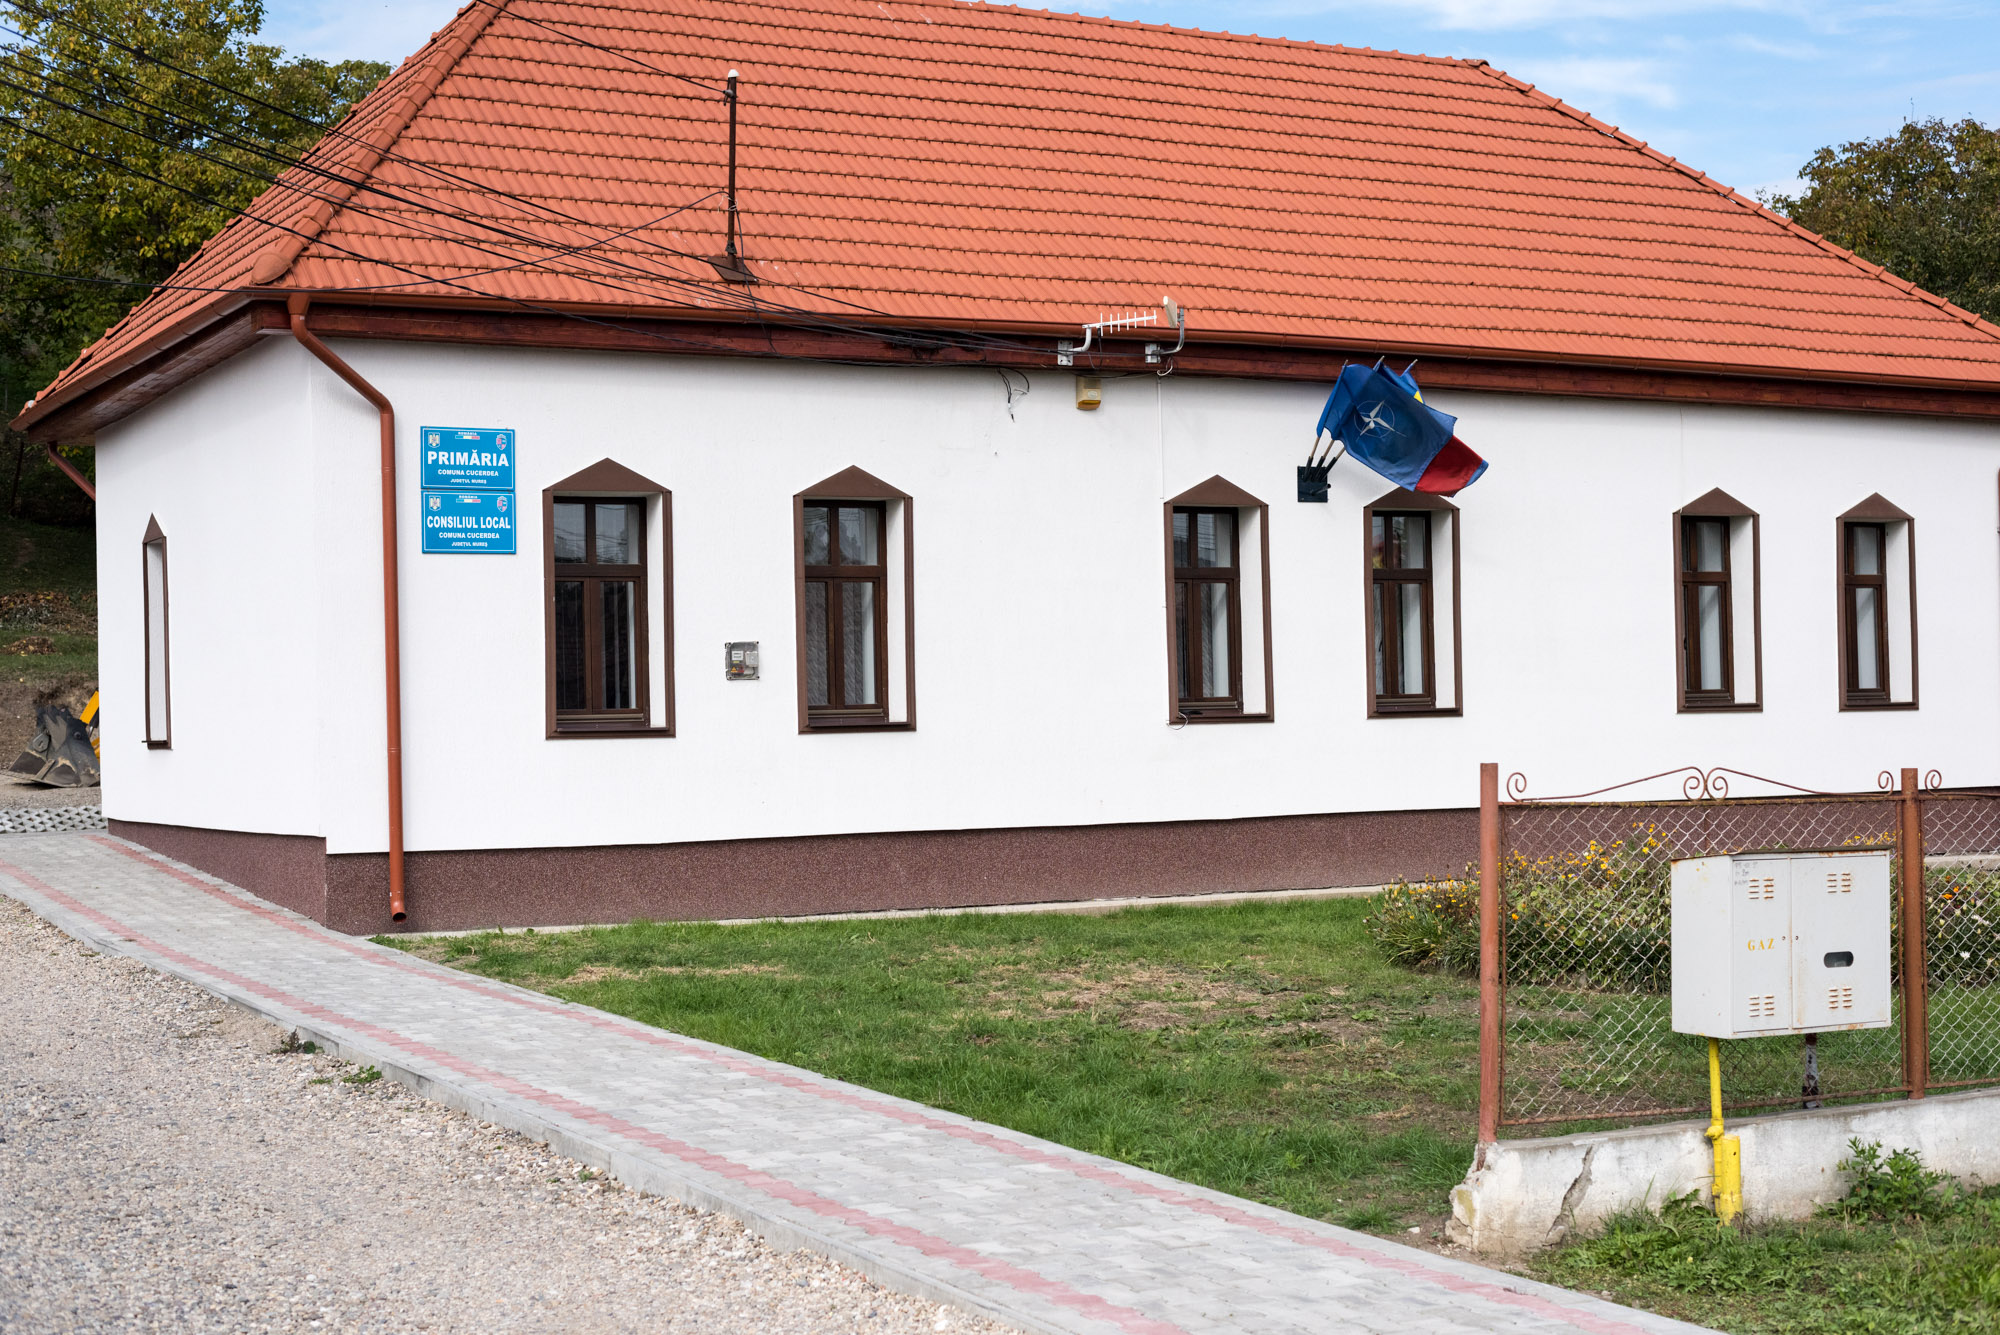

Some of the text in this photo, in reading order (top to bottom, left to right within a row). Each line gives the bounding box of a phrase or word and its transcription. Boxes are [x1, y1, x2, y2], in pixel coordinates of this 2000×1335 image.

[427, 449, 510, 467] PRIMĂRIA
[466, 469, 499, 477] CUCERDEA
[426, 515, 511, 529] CONSILIUL LOCAL
[1747, 938, 1775, 951] GAZ
